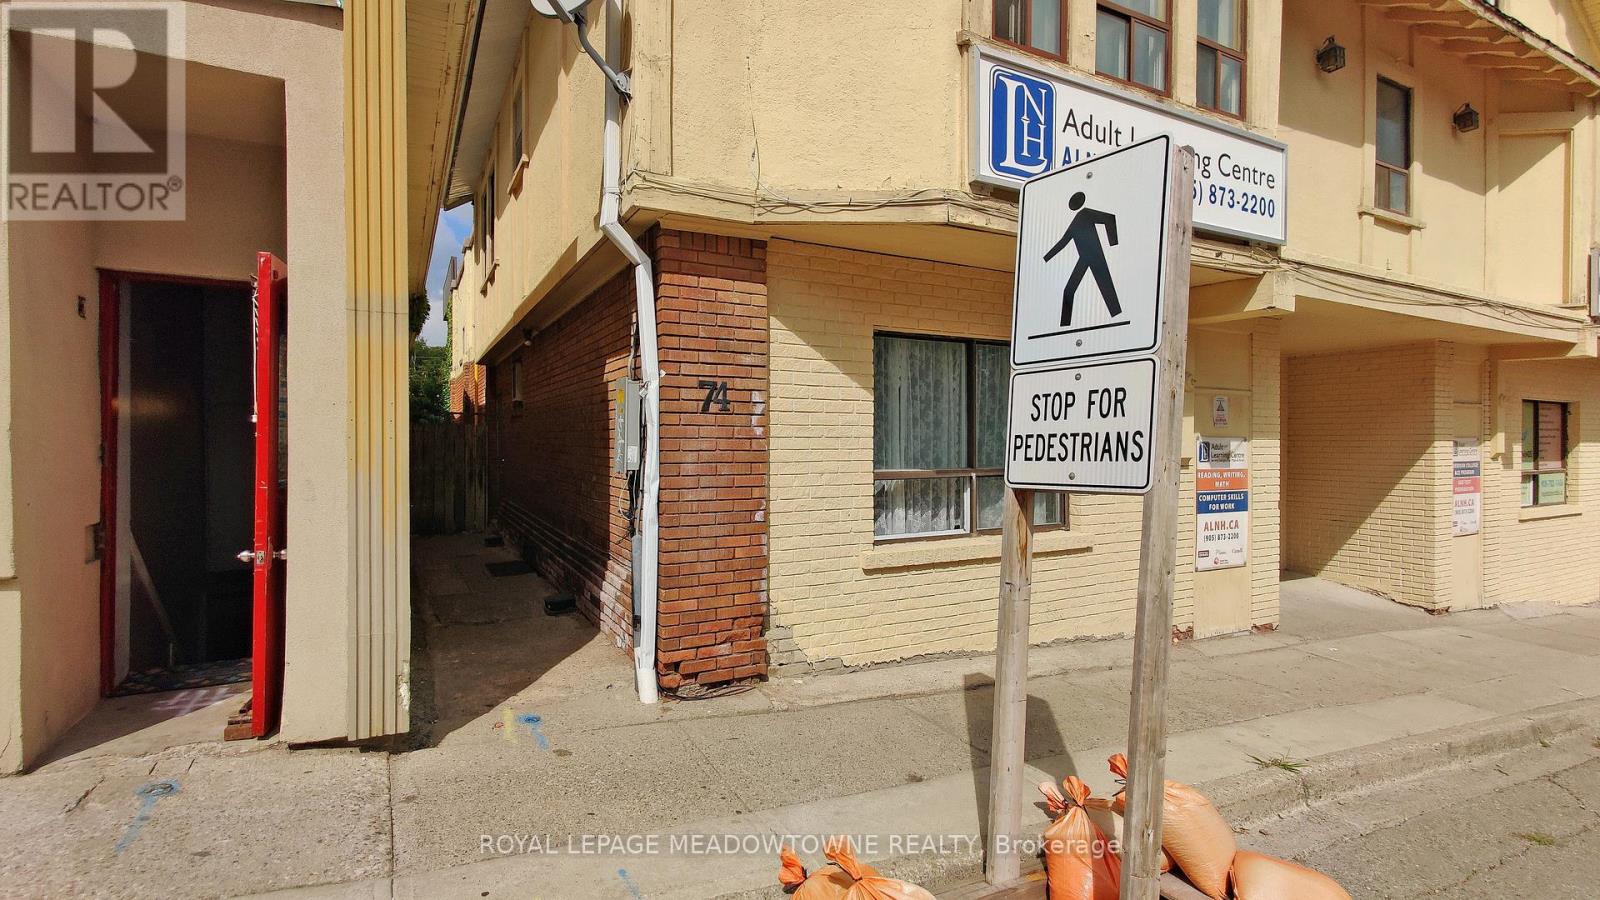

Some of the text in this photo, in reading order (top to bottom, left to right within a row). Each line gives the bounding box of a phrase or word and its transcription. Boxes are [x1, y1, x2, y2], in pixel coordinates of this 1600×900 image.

[1062, 108, 1122, 147] Adult
[1218, 153, 1275, 189] Centre
[1209, 184, 1275, 218] 873-2200
[698, 380, 731, 414] 74
[1031, 387, 1127, 422] STOP FOR
[1013, 430, 1144, 463] PEDESTRIANS
[1198, 494, 1227, 502] COMPUTER
[1208, 502, 1235, 511] FOR WORK
[1203, 519, 1239, 532] ALNH.CA
